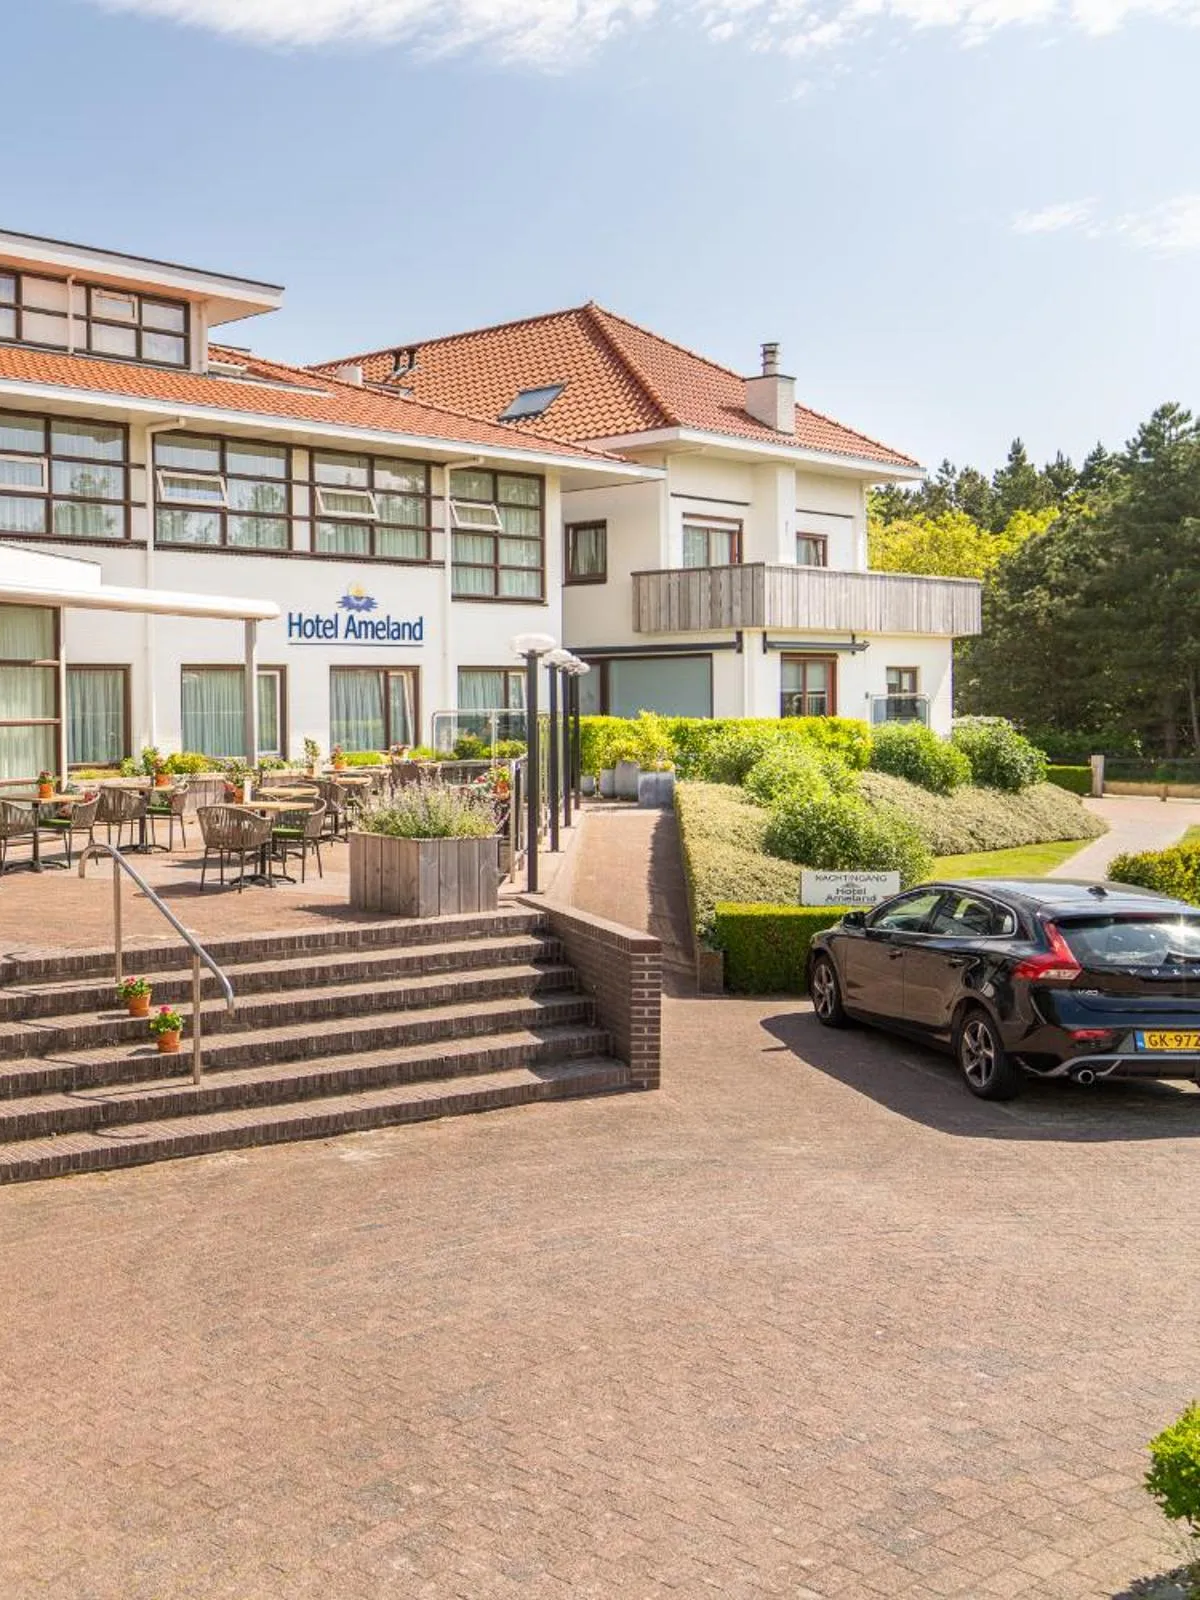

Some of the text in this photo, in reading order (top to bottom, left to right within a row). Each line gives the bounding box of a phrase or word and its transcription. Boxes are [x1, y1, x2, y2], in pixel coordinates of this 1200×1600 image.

[288, 612, 423, 640] Hotel Ameland
[836, 887, 866, 895] Hotel
[825, 894, 877, 902] Ameland
